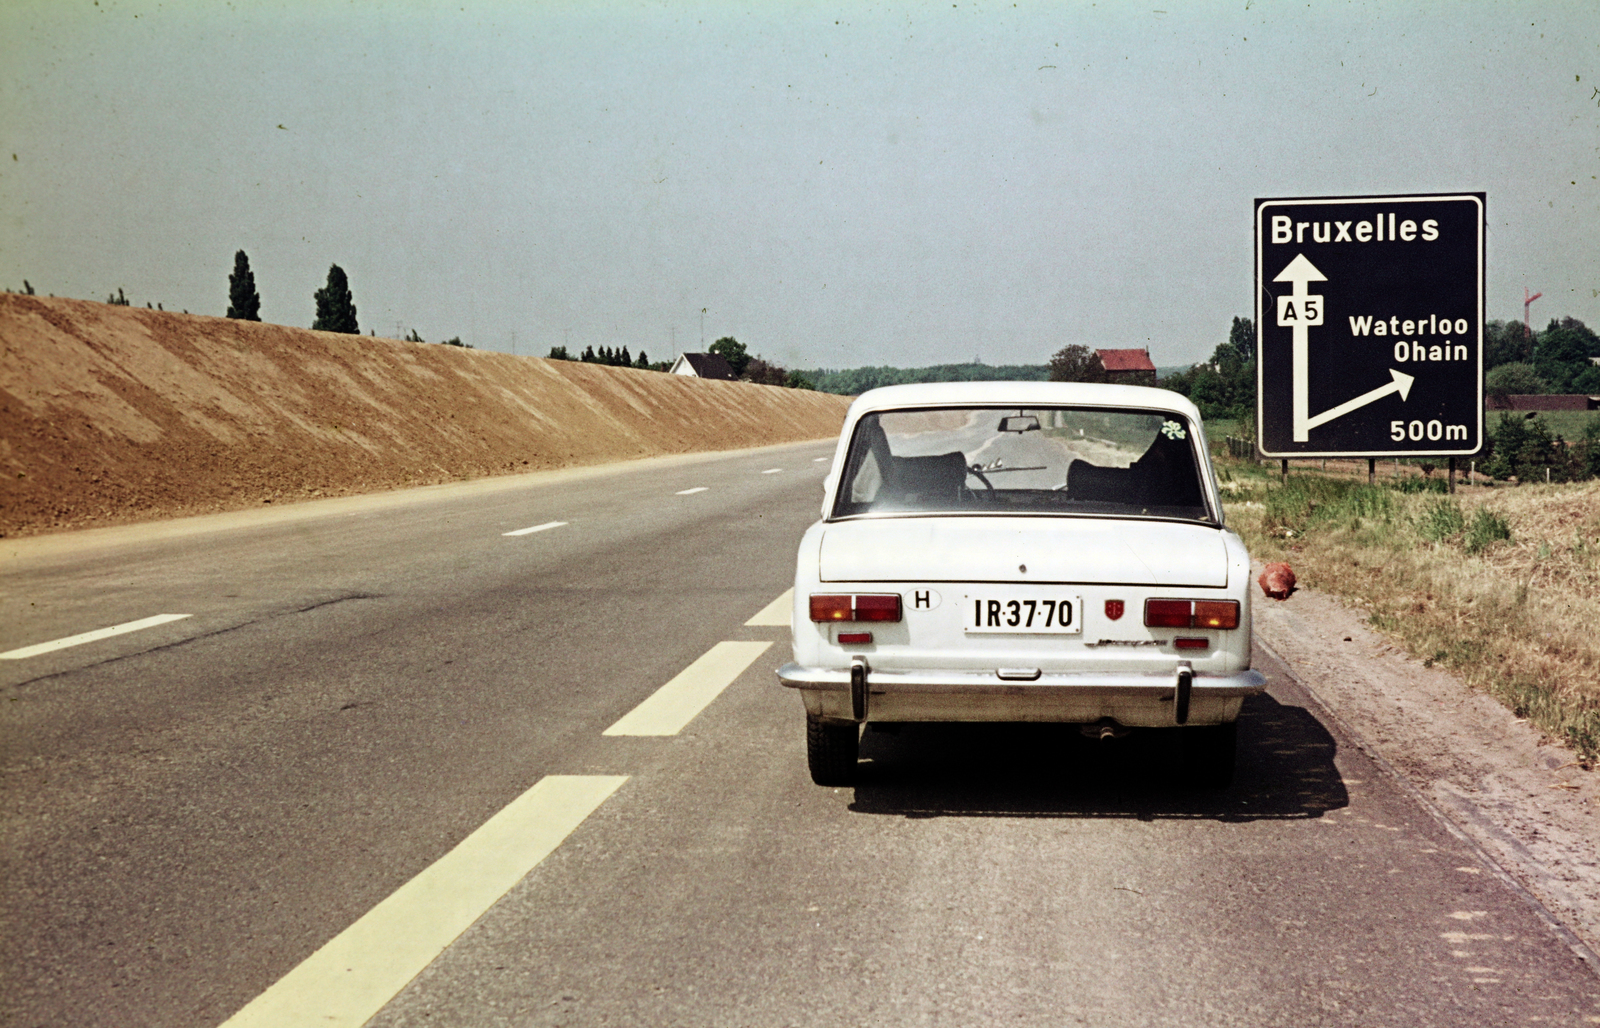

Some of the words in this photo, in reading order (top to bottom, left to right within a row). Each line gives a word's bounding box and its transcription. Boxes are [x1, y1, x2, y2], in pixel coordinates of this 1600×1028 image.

[1271, 212, 1439, 244] Bruxelles
[1348, 313, 1468, 337] Waterloo
[1394, 339, 1468, 363] Ohain
[1390, 419, 1468, 442] 500m
[914, 590, 930, 609] H
